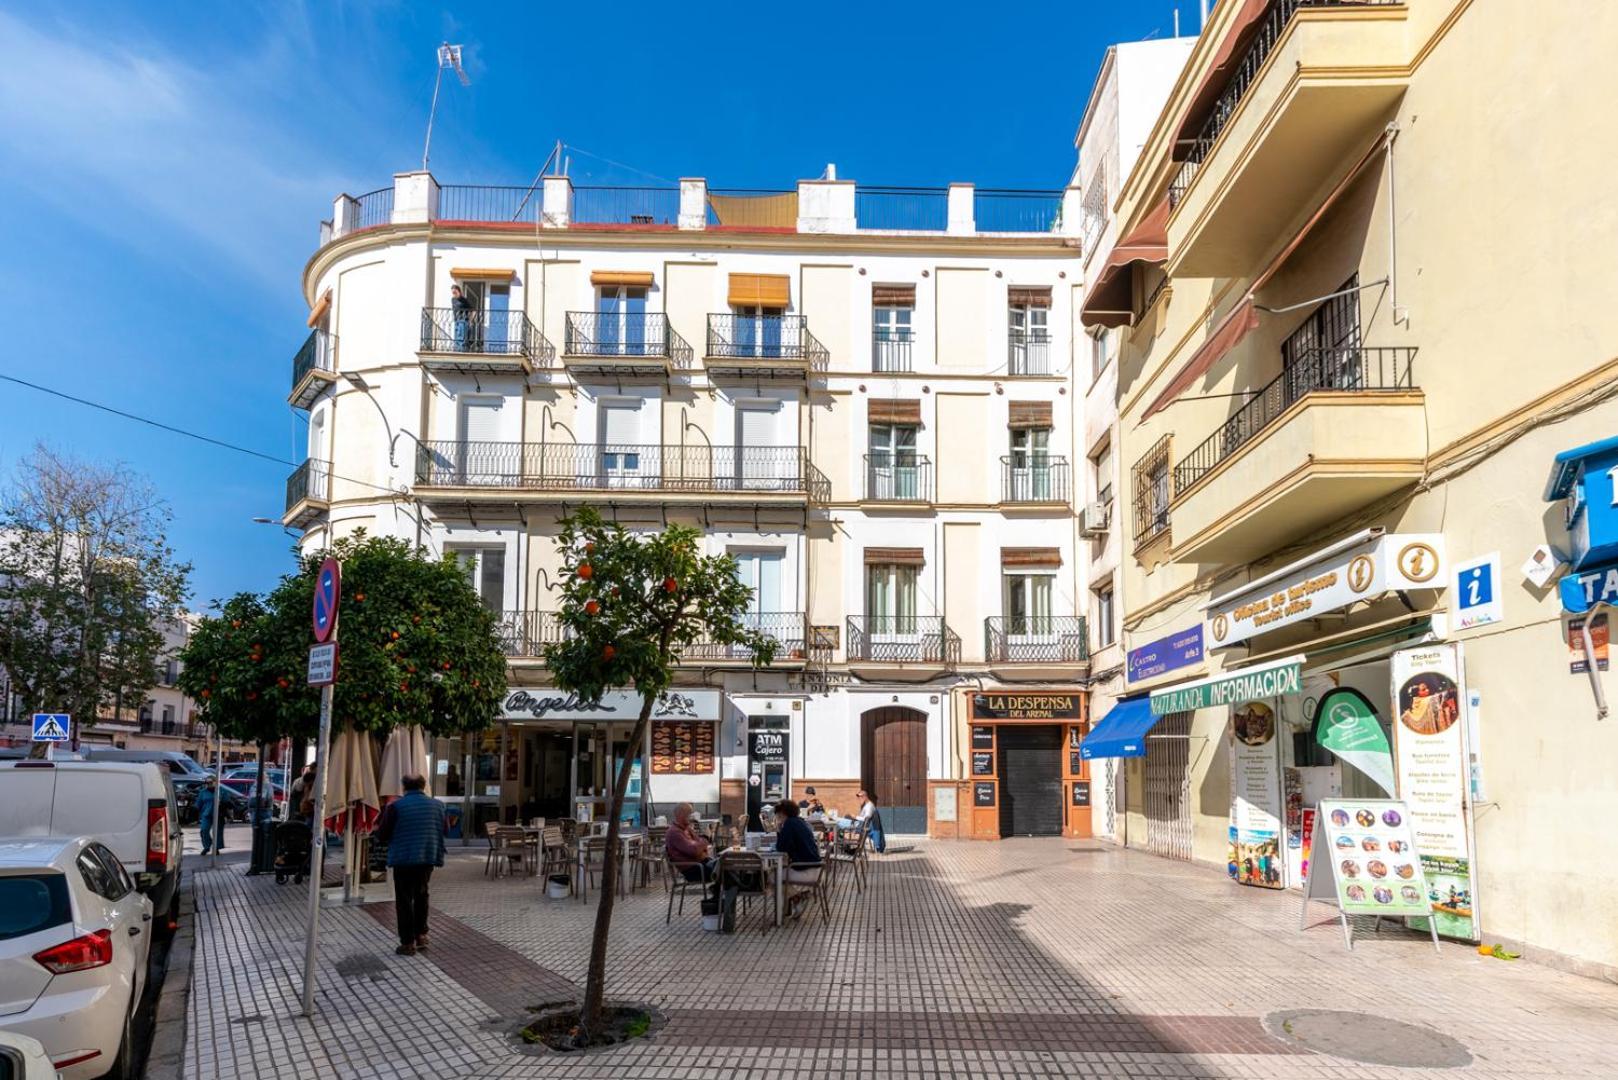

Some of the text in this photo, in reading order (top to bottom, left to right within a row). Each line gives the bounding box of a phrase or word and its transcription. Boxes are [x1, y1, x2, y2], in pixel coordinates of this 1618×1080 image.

[1233, 572, 1338, 622] Oficina de turismo
[1252, 599, 1312, 627] Tourist office
[1411, 652, 1441, 661] Tickets
[1151, 665, 1299, 714] NATURANDA INFORMACION
[988, 696, 1073, 710] LA DESPENSA
[1009, 709, 1054, 718] DEL ARENAL
[756, 734, 783, 746] ATM
[754, 745, 783, 756] Cajero
